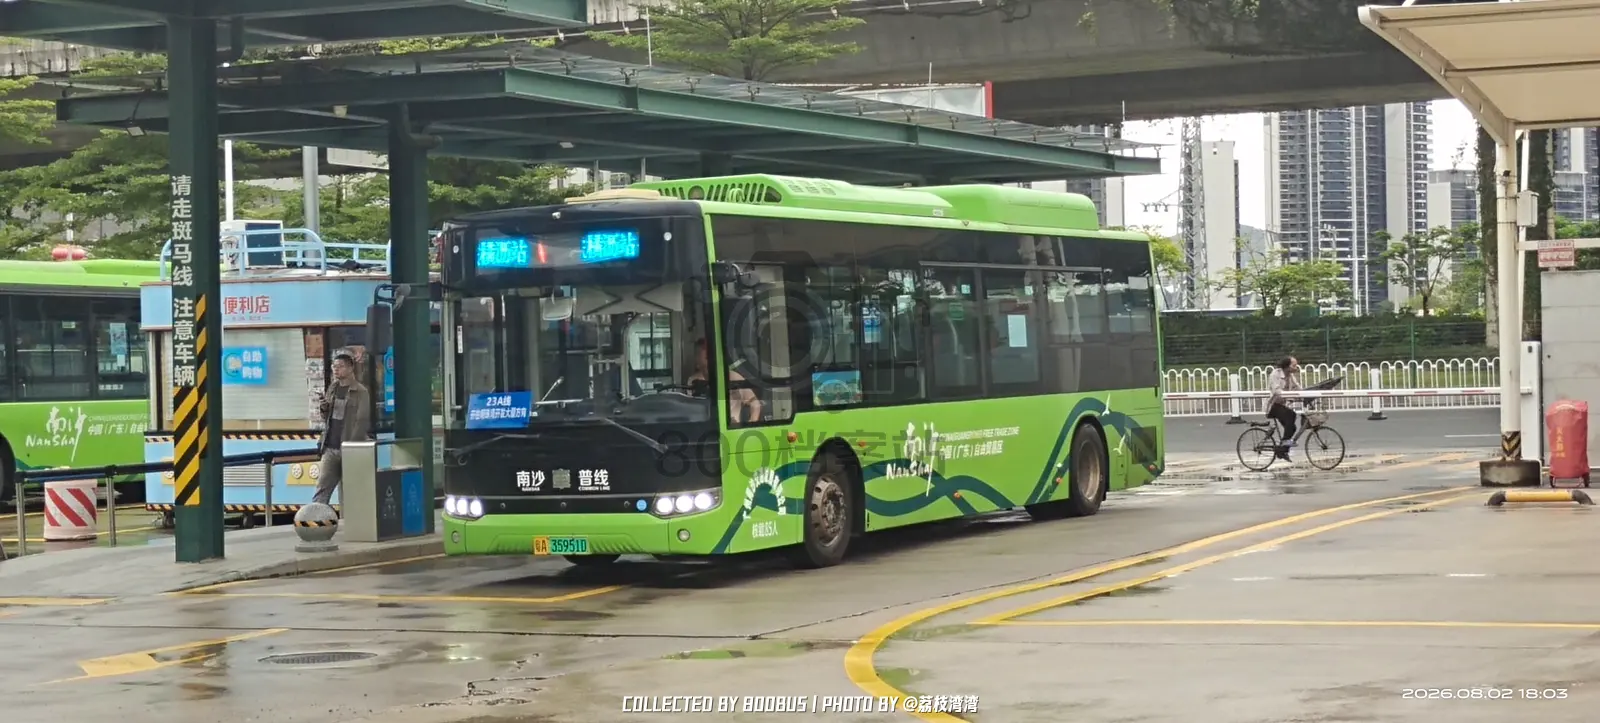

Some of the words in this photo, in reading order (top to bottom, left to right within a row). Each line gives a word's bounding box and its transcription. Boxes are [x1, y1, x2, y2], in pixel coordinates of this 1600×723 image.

[172, 176, 192, 286] 请走斑马线
[223, 295, 270, 315] 便利店
[174, 297, 194, 387] 注意车辆
[486, 395, 512, 407] 23A线
[516, 470, 545, 488] 南沙
[578, 469, 609, 486] 普线
